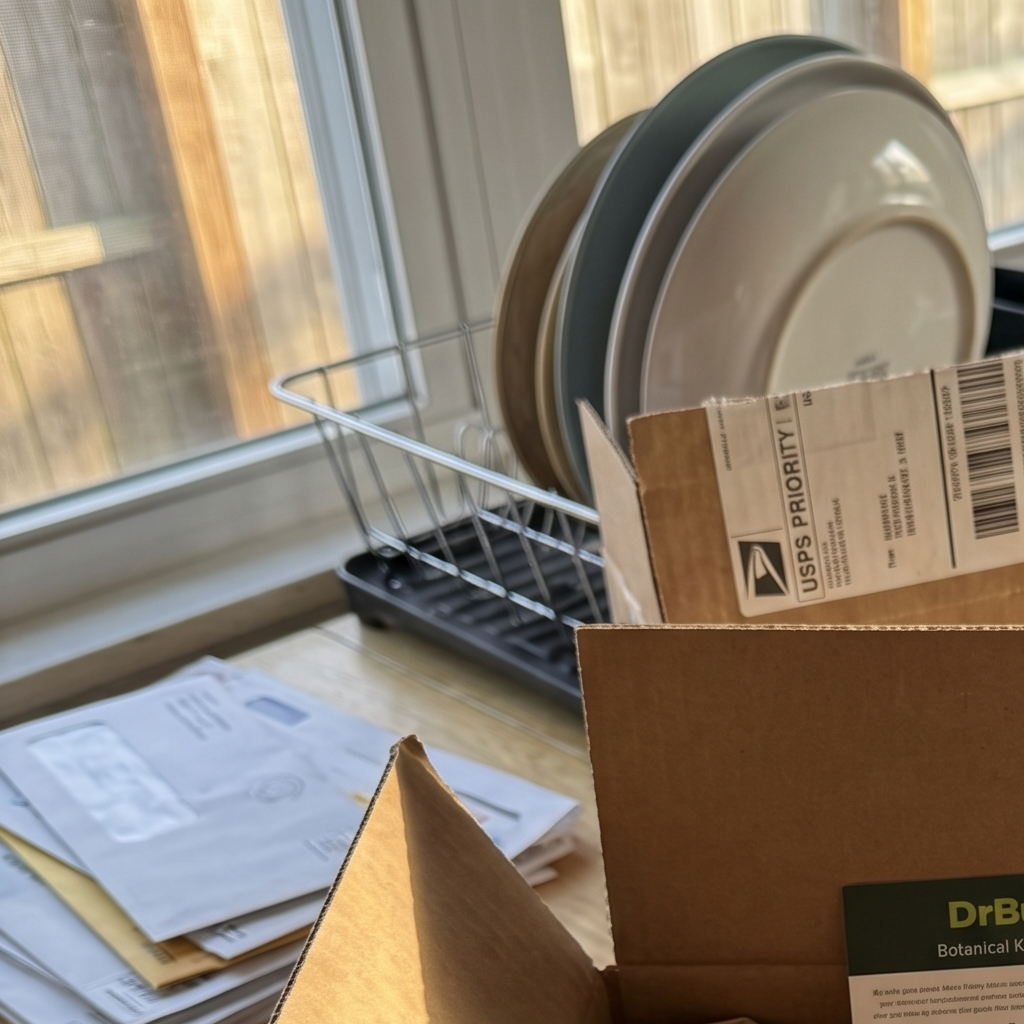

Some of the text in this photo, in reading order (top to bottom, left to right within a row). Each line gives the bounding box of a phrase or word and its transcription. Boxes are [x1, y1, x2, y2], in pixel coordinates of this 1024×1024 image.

[777, 429, 808, 529] PRIORITY
[796, 535, 818, 593] USPS
[937, 940, 1010, 958] Botanical
